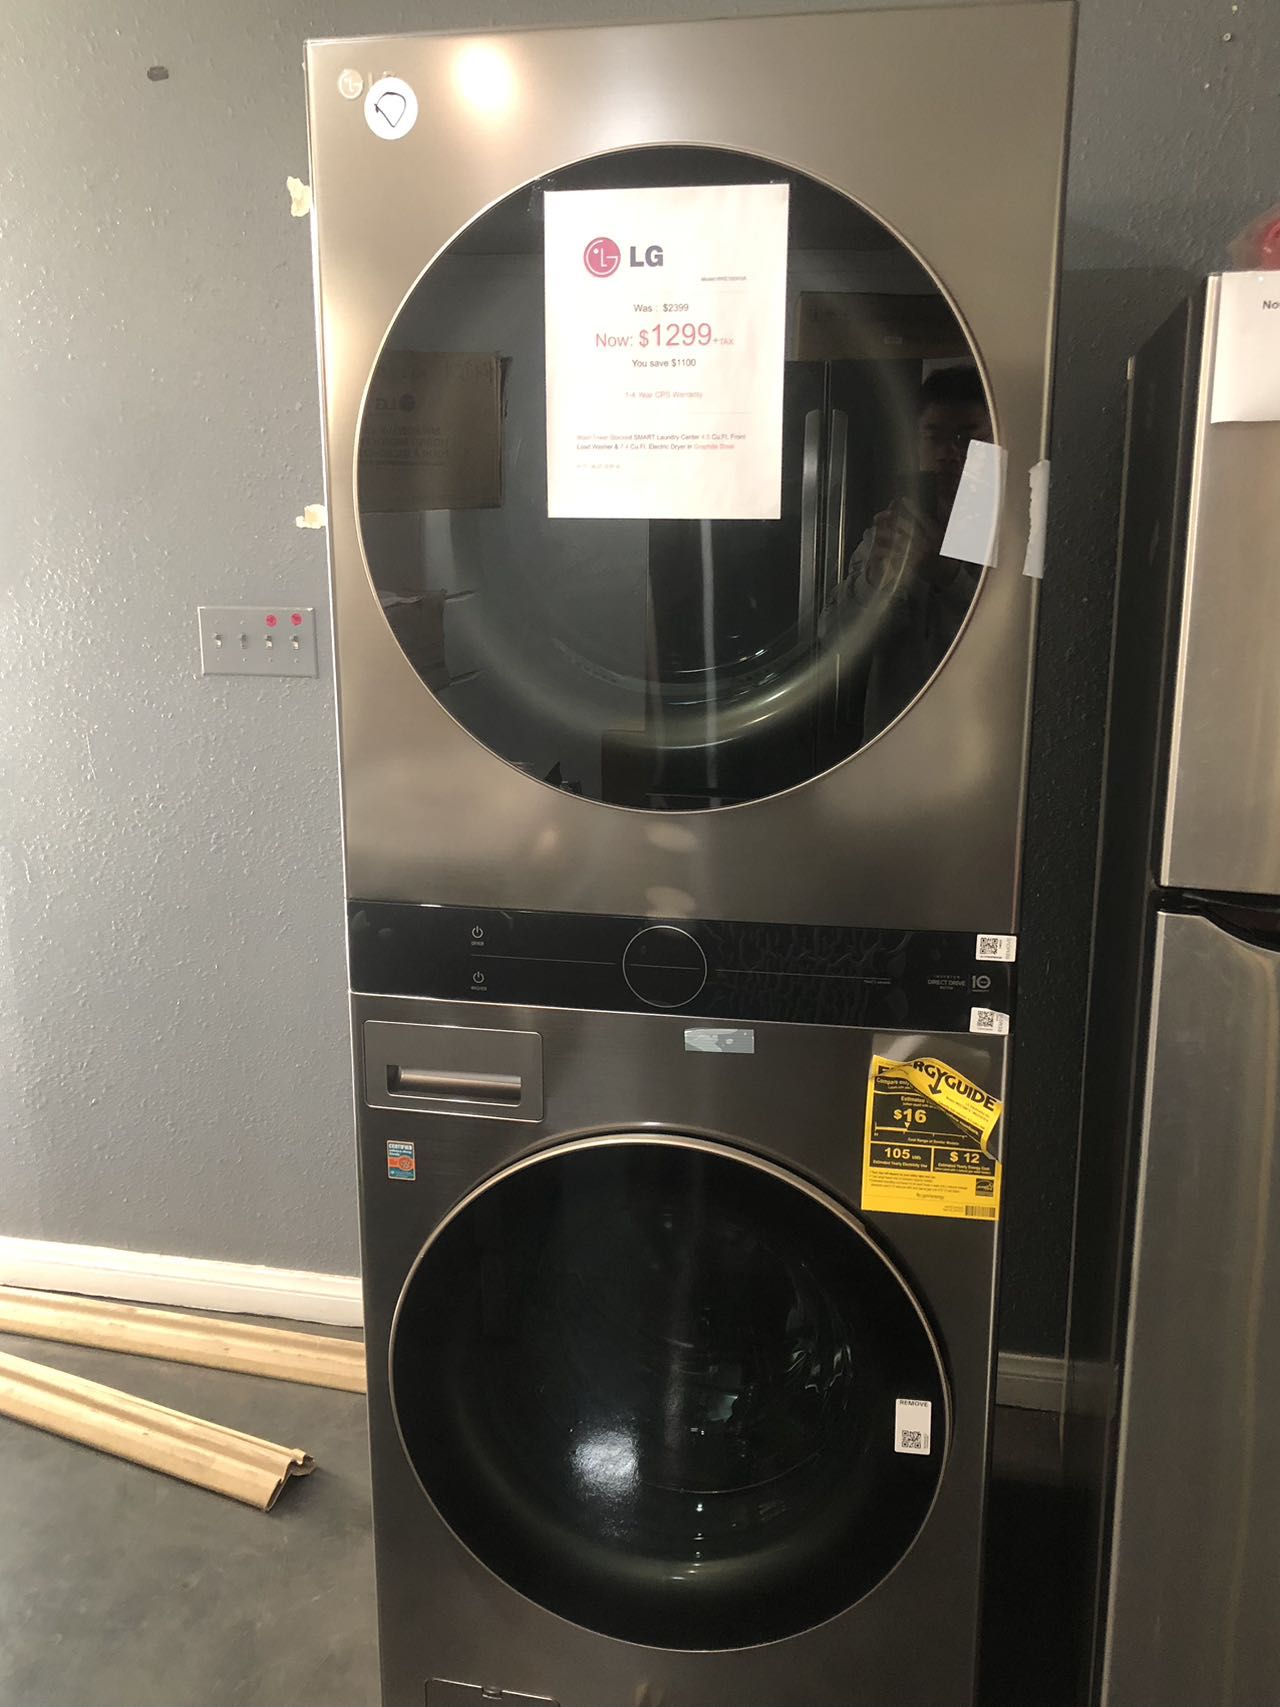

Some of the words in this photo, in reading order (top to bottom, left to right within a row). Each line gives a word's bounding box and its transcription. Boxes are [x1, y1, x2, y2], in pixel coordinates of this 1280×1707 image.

[630, 245, 664, 268] LG
[633, 304, 652, 312] Was
[662, 303, 689, 312] $2399
[1263, 300, 1280, 310] No
[595, 332, 633, 347] Now:
[638, 322, 712, 348] $1299
[632, 360, 648, 368] You
[672, 358, 697, 368] $1100
[670, 443, 686, 451] Dryer
[893, 1108, 927, 1123] $16
[884, 1147, 910, 1159] 105
[964, 1152, 980, 1164] 12
